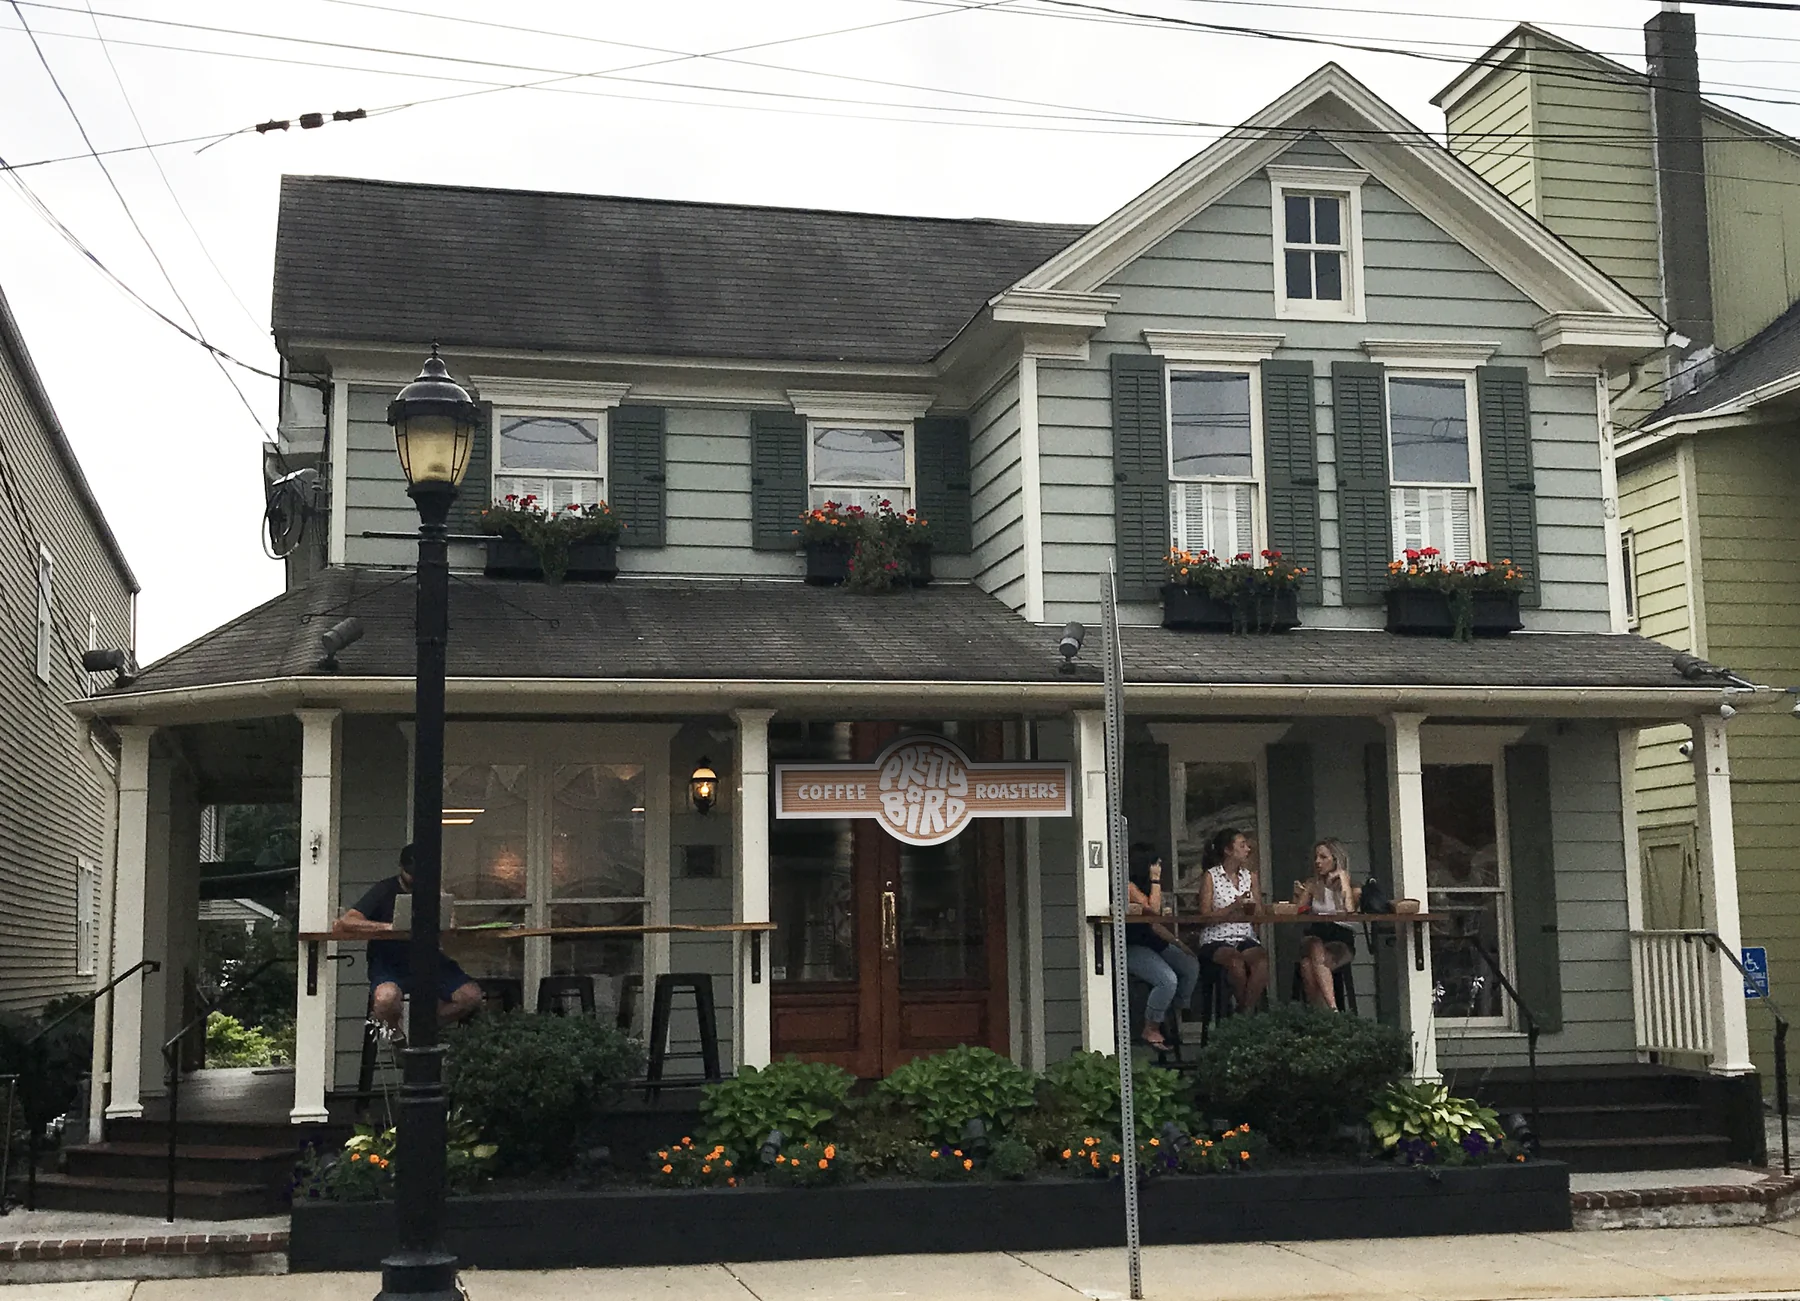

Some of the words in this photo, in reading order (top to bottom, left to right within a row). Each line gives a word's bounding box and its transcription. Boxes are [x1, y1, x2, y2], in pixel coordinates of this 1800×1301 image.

[879, 745, 968, 797] PRETTY
[798, 784, 867, 800] COFFEE
[975, 783, 1059, 799] ROASTERS
[880, 788, 966, 836] BIRD
[1091, 843, 1101, 865] 7
